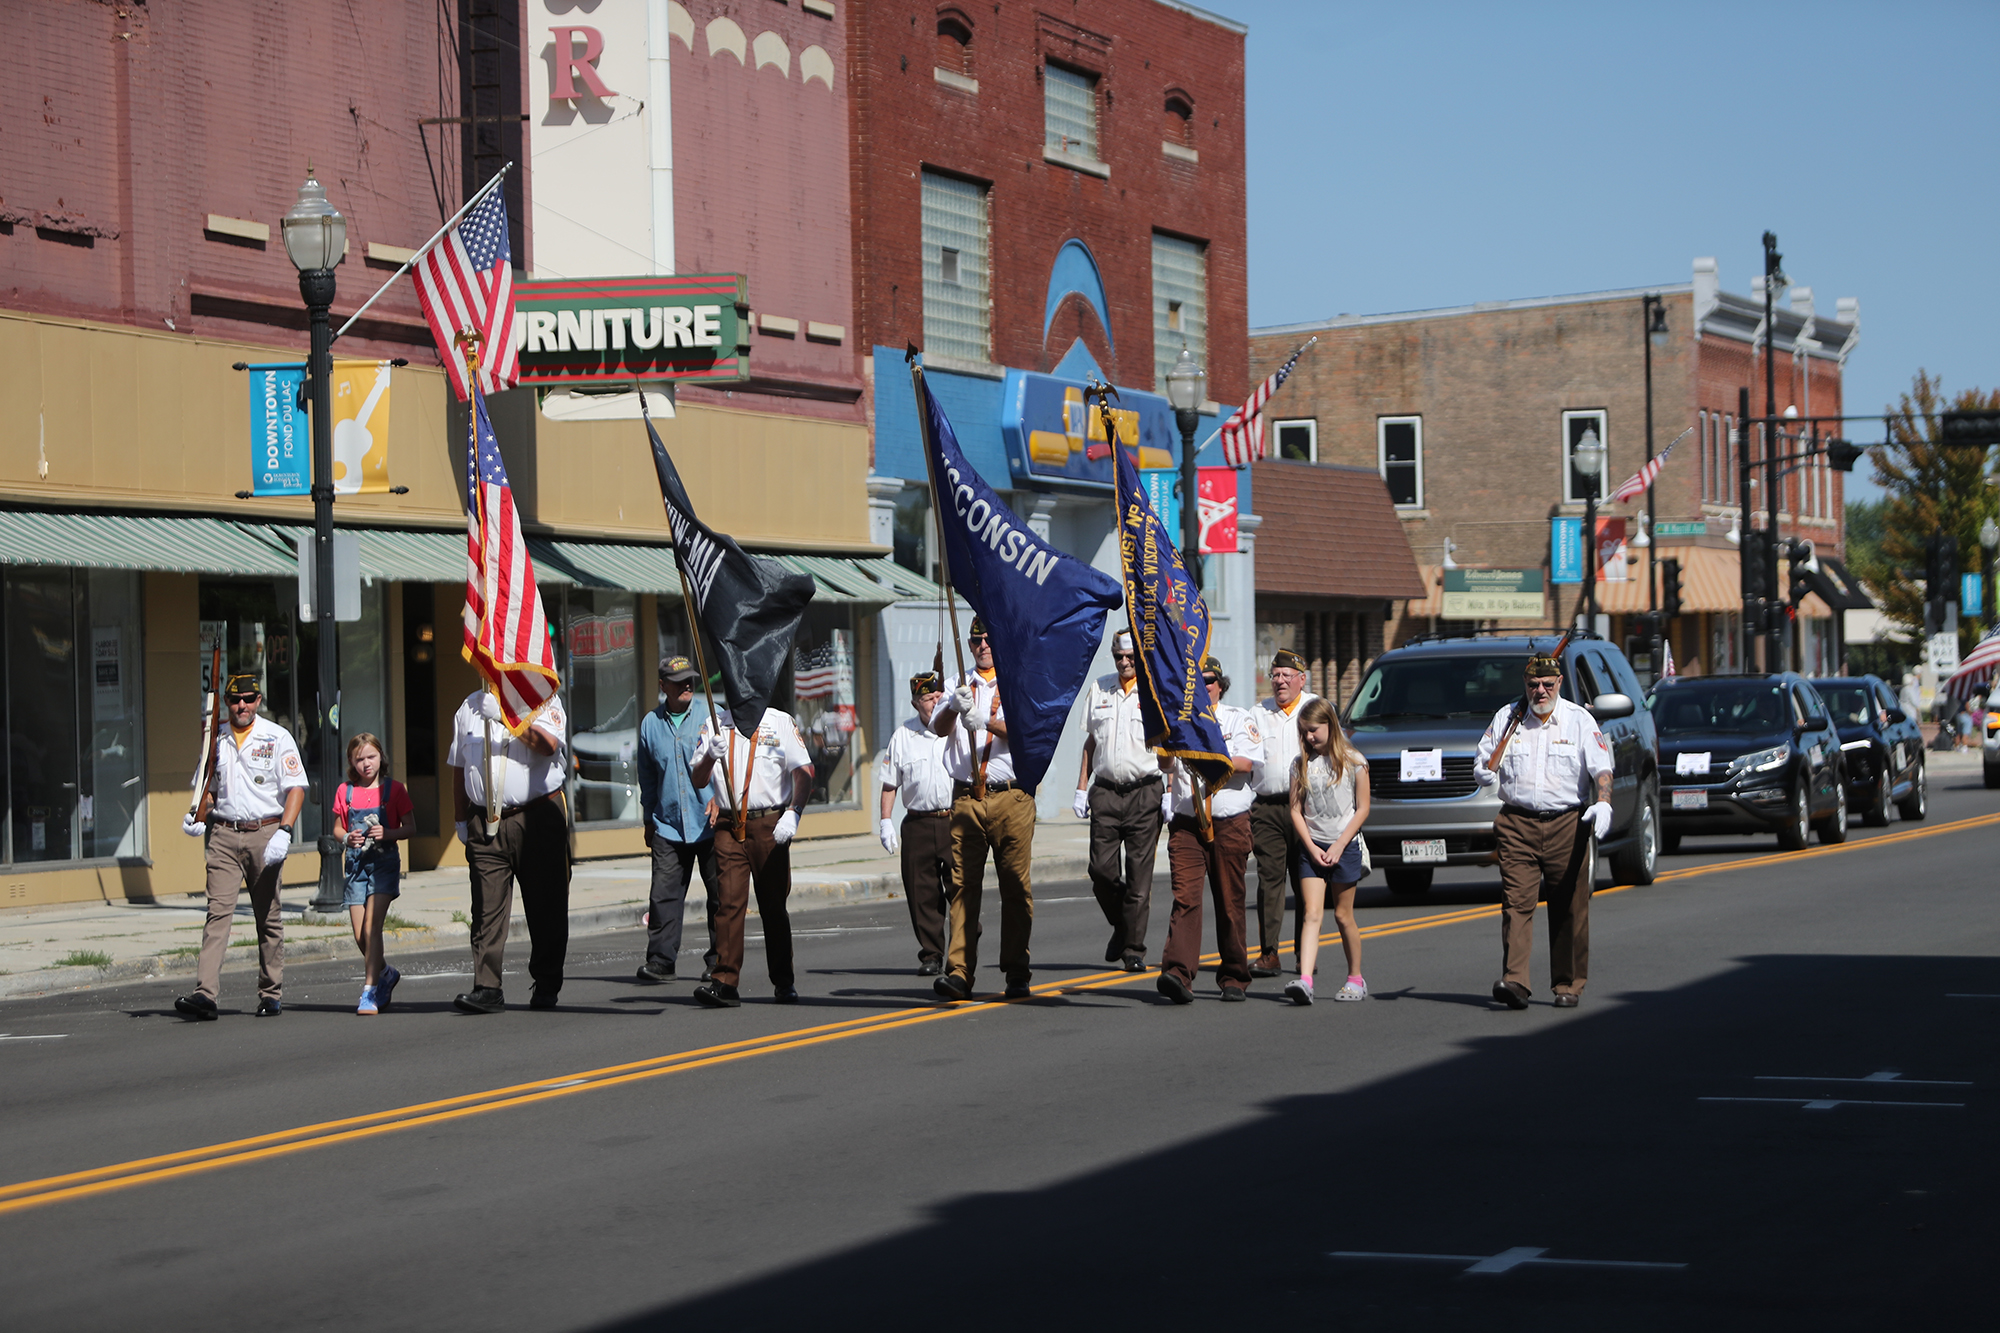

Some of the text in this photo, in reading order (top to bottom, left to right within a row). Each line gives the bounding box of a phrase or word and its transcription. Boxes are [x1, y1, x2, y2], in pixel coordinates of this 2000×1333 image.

[265, 370, 279, 469] DOWNTOWN
[281, 380, 294, 458] FOND DU LAC
[687, 529, 726, 612] MIA
[1122, 530, 1138, 573] POST
[1144, 605, 1157, 620] DU
[1144, 622, 1156, 651] FOND
[1177, 657, 1196, 722] Mustered
